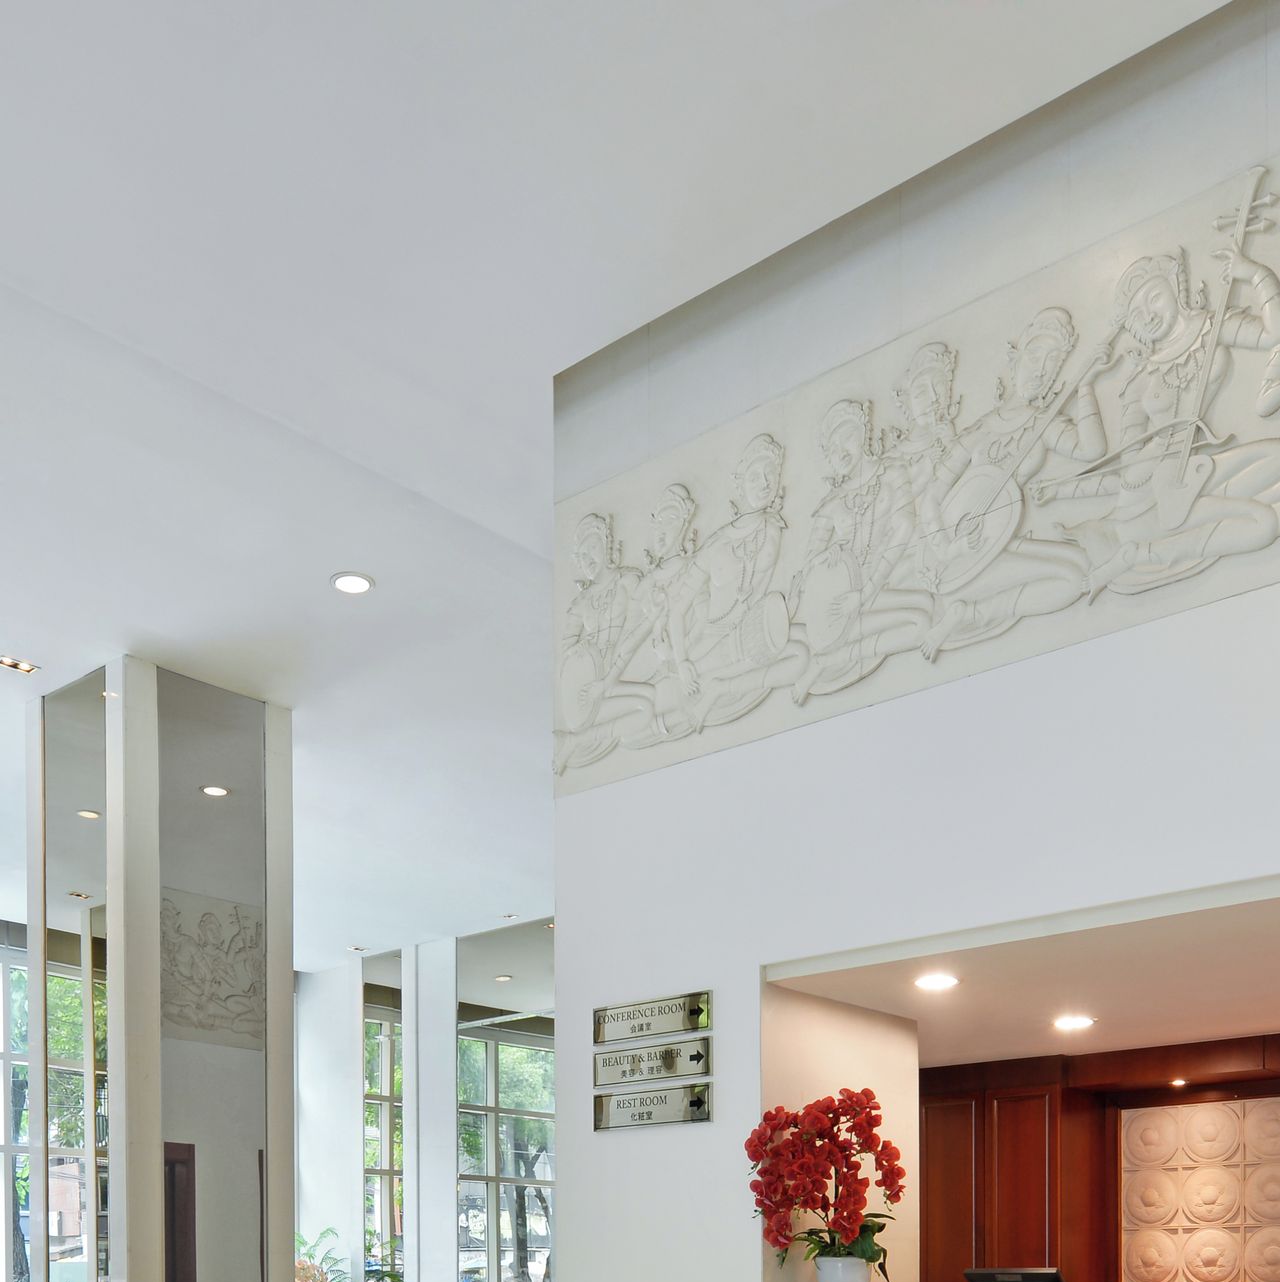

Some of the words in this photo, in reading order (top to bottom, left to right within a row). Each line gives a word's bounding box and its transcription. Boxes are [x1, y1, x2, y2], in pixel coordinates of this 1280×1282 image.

[597, 1007, 656, 1025] CONFERENCE
[656, 1002, 687, 1016] ROOM
[602, 1054, 638, 1068] BEAUTY
[637, 1053, 645, 1063] &
[647, 1048, 682, 1062] BARBER
[616, 1096, 639, 1109] REST
[639, 1095, 668, 1107] ROOM
